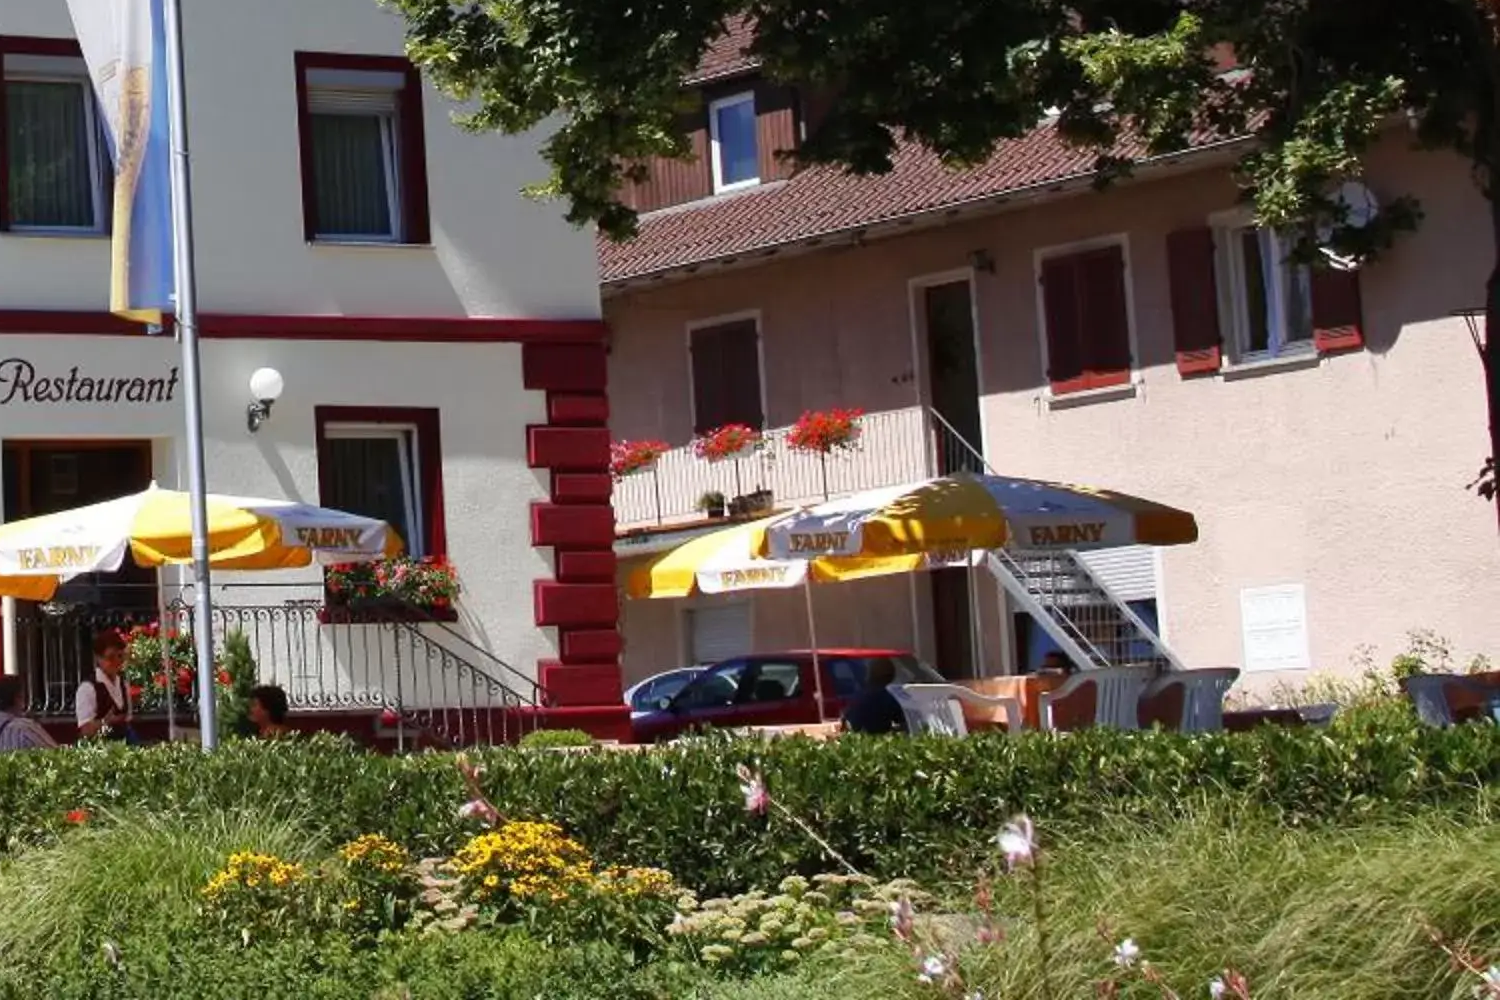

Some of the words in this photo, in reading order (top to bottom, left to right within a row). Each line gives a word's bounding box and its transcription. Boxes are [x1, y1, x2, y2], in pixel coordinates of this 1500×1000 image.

[295, 527, 363, 548] FARNY
[789, 531, 849, 552] FARNY
[1027, 522, 1106, 545] FARNY
[17, 546, 103, 569] FARNY
[719, 566, 788, 587] FARNY
